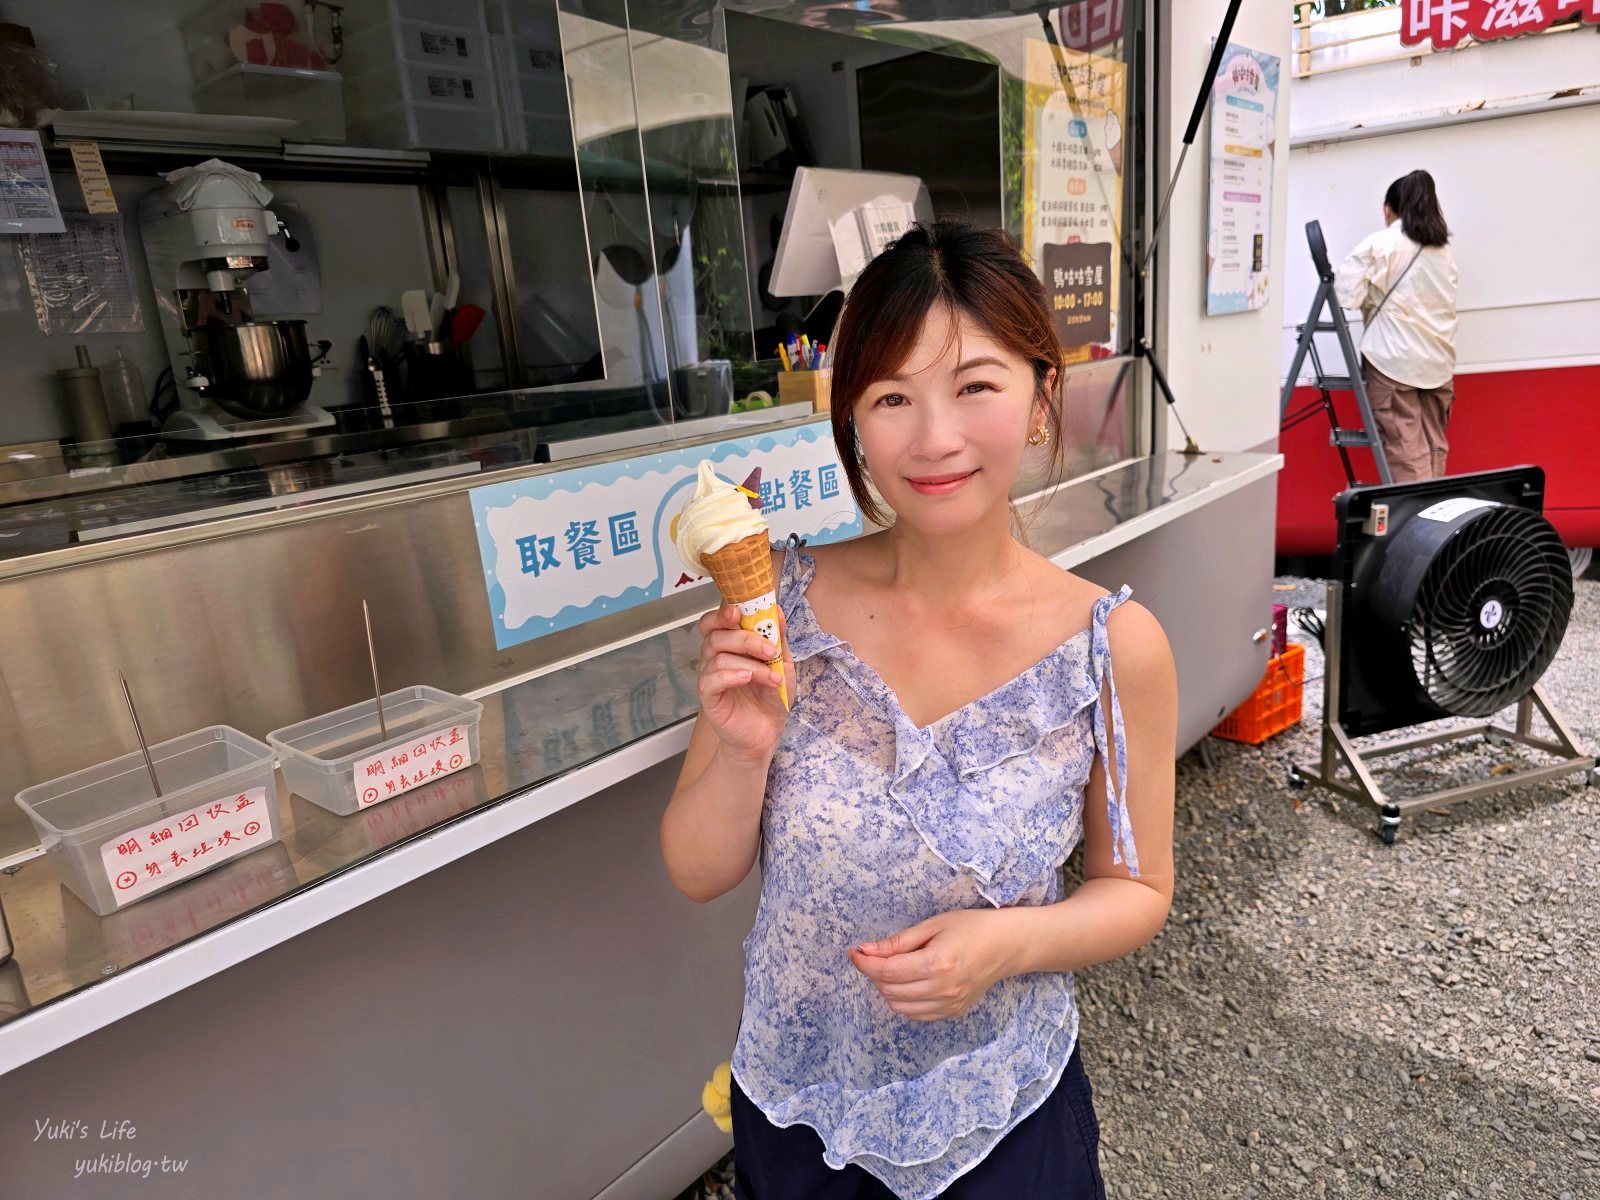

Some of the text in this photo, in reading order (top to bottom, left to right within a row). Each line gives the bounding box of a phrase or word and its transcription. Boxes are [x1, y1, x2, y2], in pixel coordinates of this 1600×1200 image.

[1053, 293, 1076, 310] 10:00
[1083, 291, 1103, 308] 17:00
[759, 463, 840, 516] 點餐區
[515, 511, 642, 578] 取餐區
[366, 727, 464, 777] 明細回收盒
[116, 793, 255, 856] 明細回收盒
